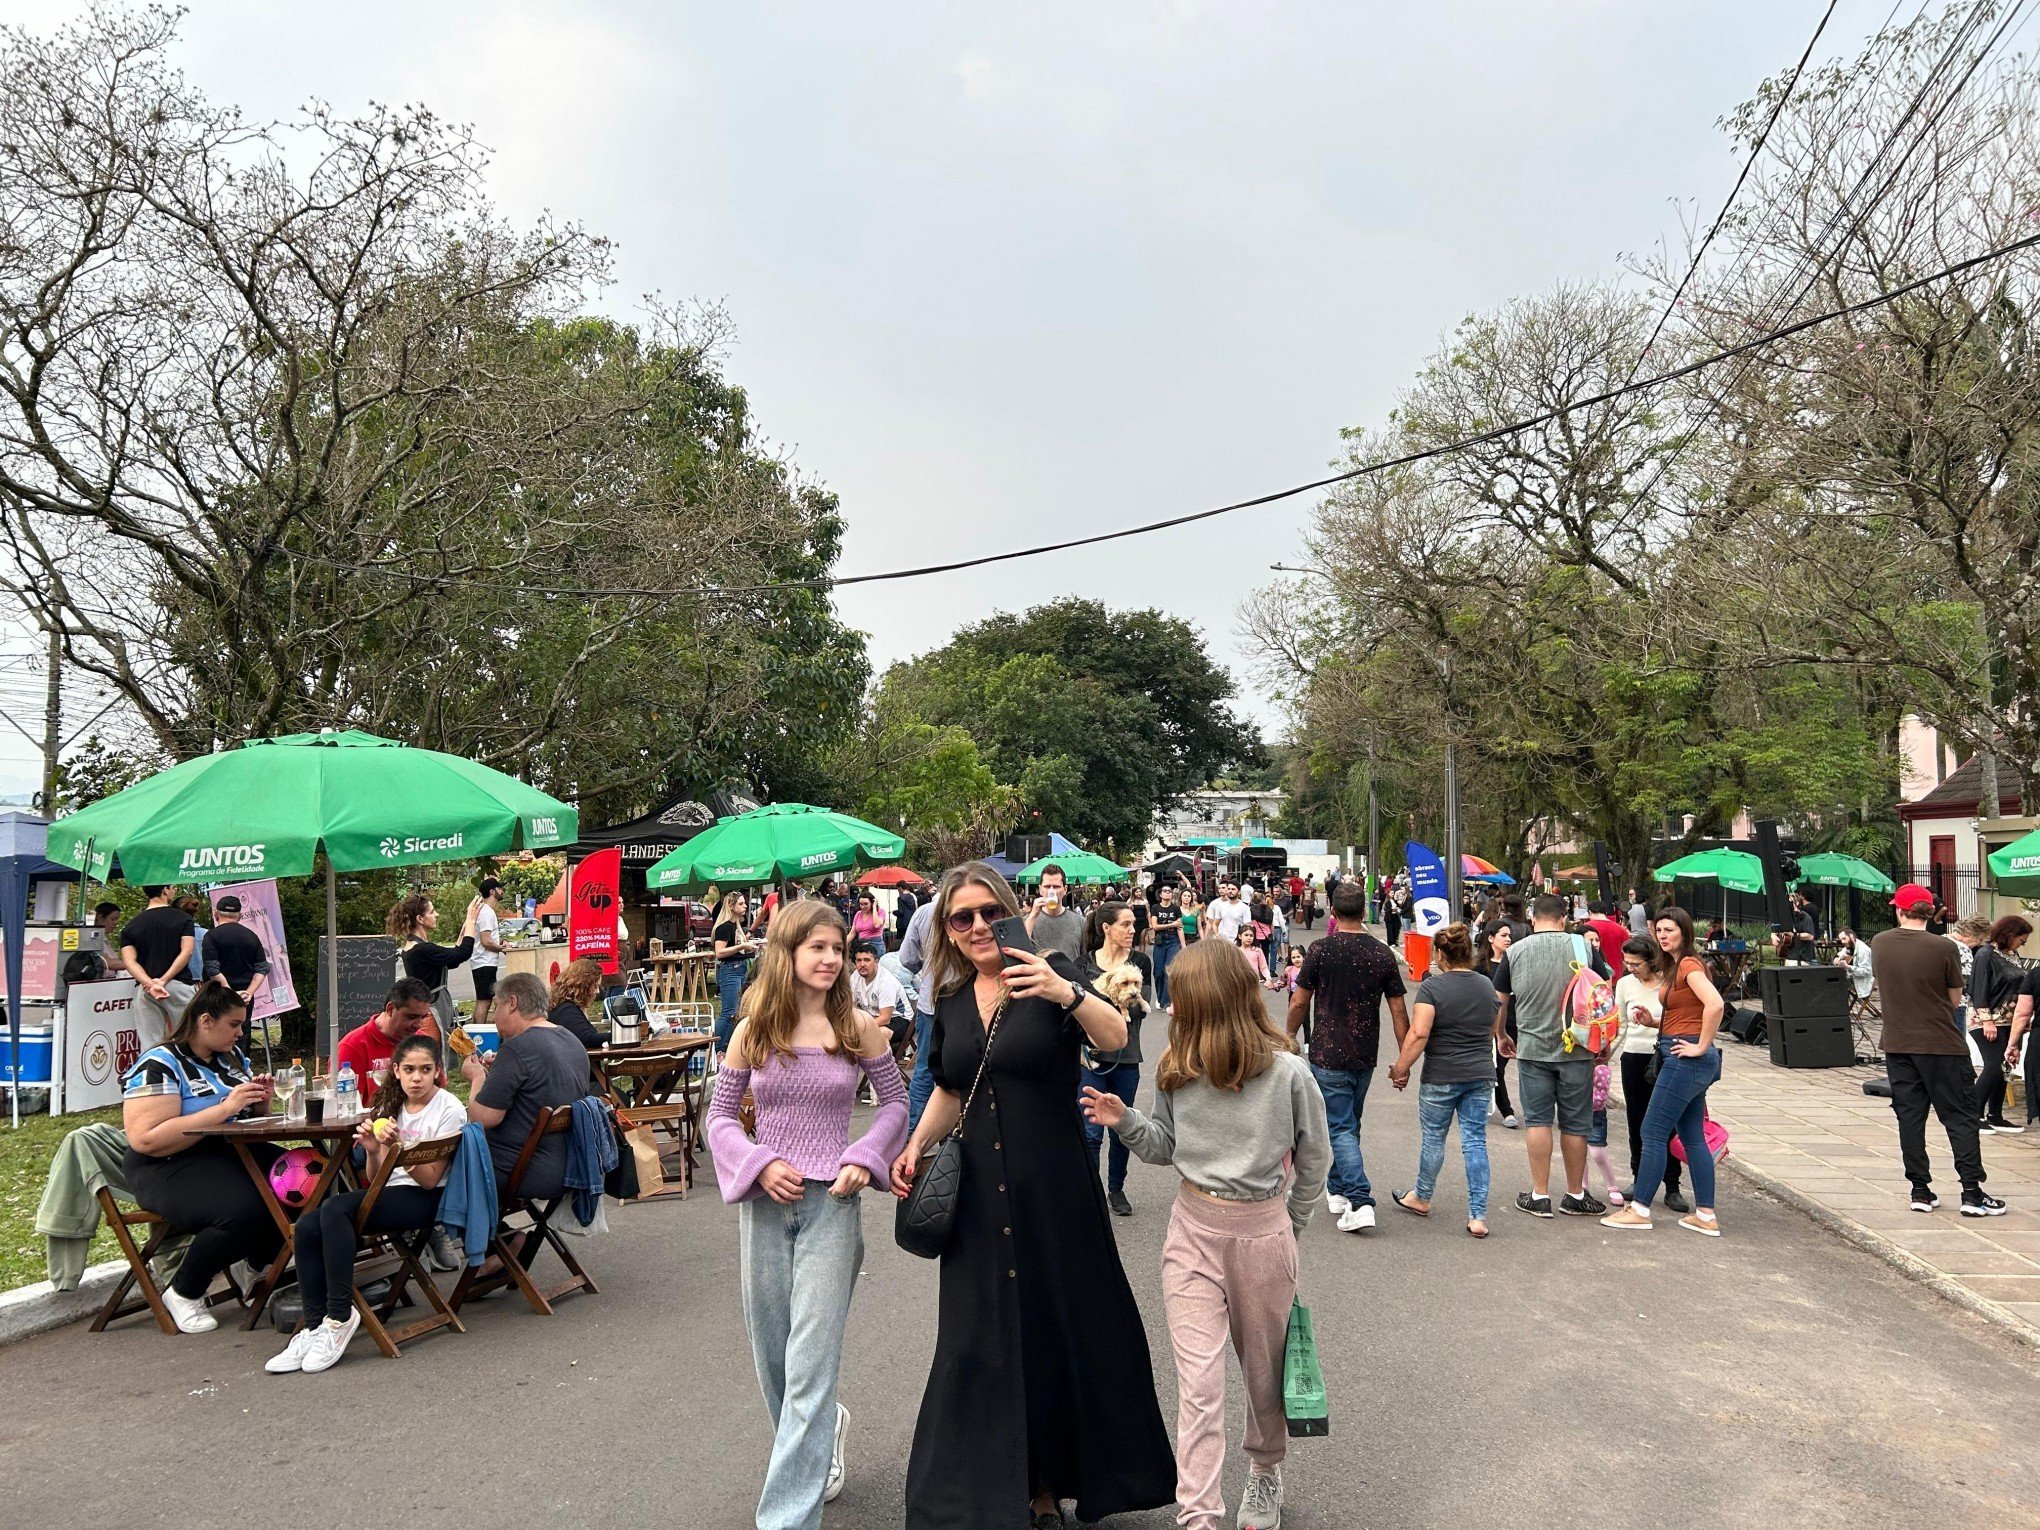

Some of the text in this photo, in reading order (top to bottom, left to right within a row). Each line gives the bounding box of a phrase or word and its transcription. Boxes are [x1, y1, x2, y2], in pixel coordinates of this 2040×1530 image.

[532, 817, 558, 836] JUNTOS
[403, 832, 463, 853] Sicredi
[179, 843, 266, 869] JUNTOS
[800, 850, 837, 867] JUNTOS
[178, 864, 265, 878] Programa de Fidelidade
[726, 866, 755, 875] Sicredi
[593, 926, 612, 934] CAFÉ
[575, 940, 612, 951] CAFEÍNA
[405, 1149, 438, 1160] JUNTOS
